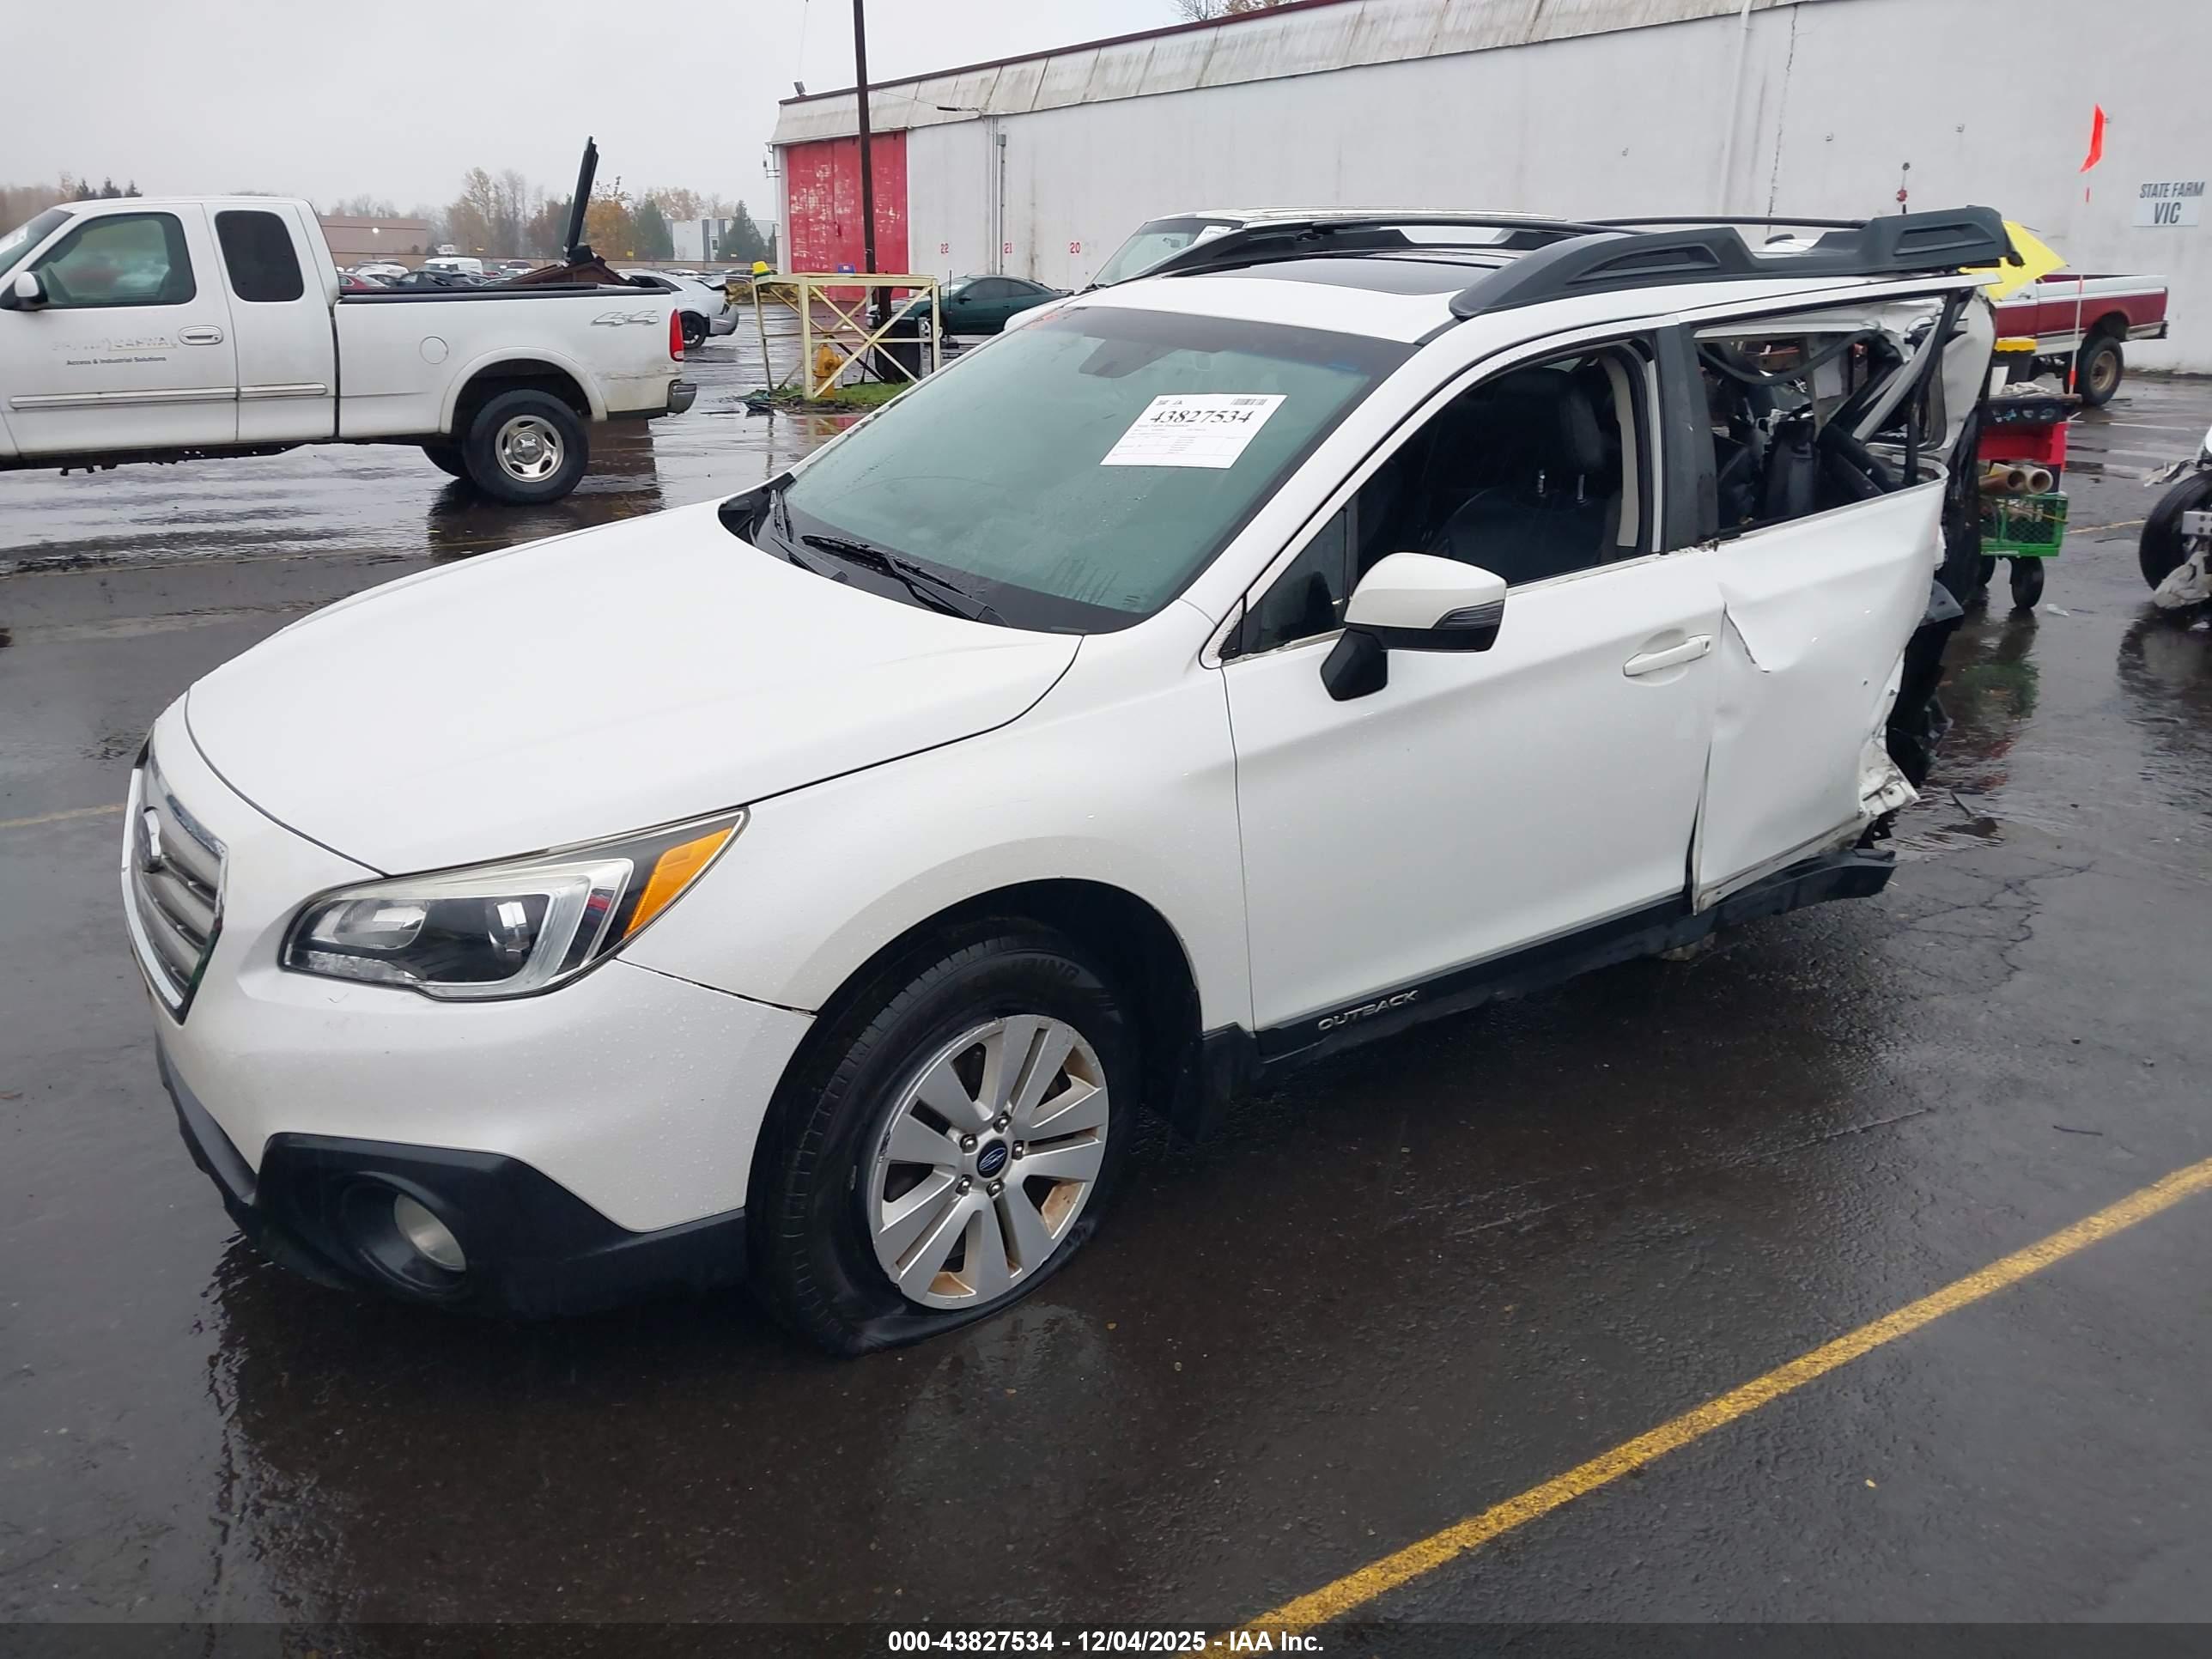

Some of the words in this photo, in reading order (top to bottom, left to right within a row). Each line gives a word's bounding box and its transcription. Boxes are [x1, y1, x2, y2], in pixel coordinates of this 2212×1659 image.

[2140, 183, 2171, 198] STATE
[2171, 181, 2205, 198] FARM
[2154, 202, 2182, 224] VIC
[940, 243, 949, 253] 22
[1003, 243, 1012, 253] 21
[1070, 242, 1080, 253] 20
[1150, 410, 1255, 423] 43827534
[1318, 990, 1419, 1031] OUTBACK
